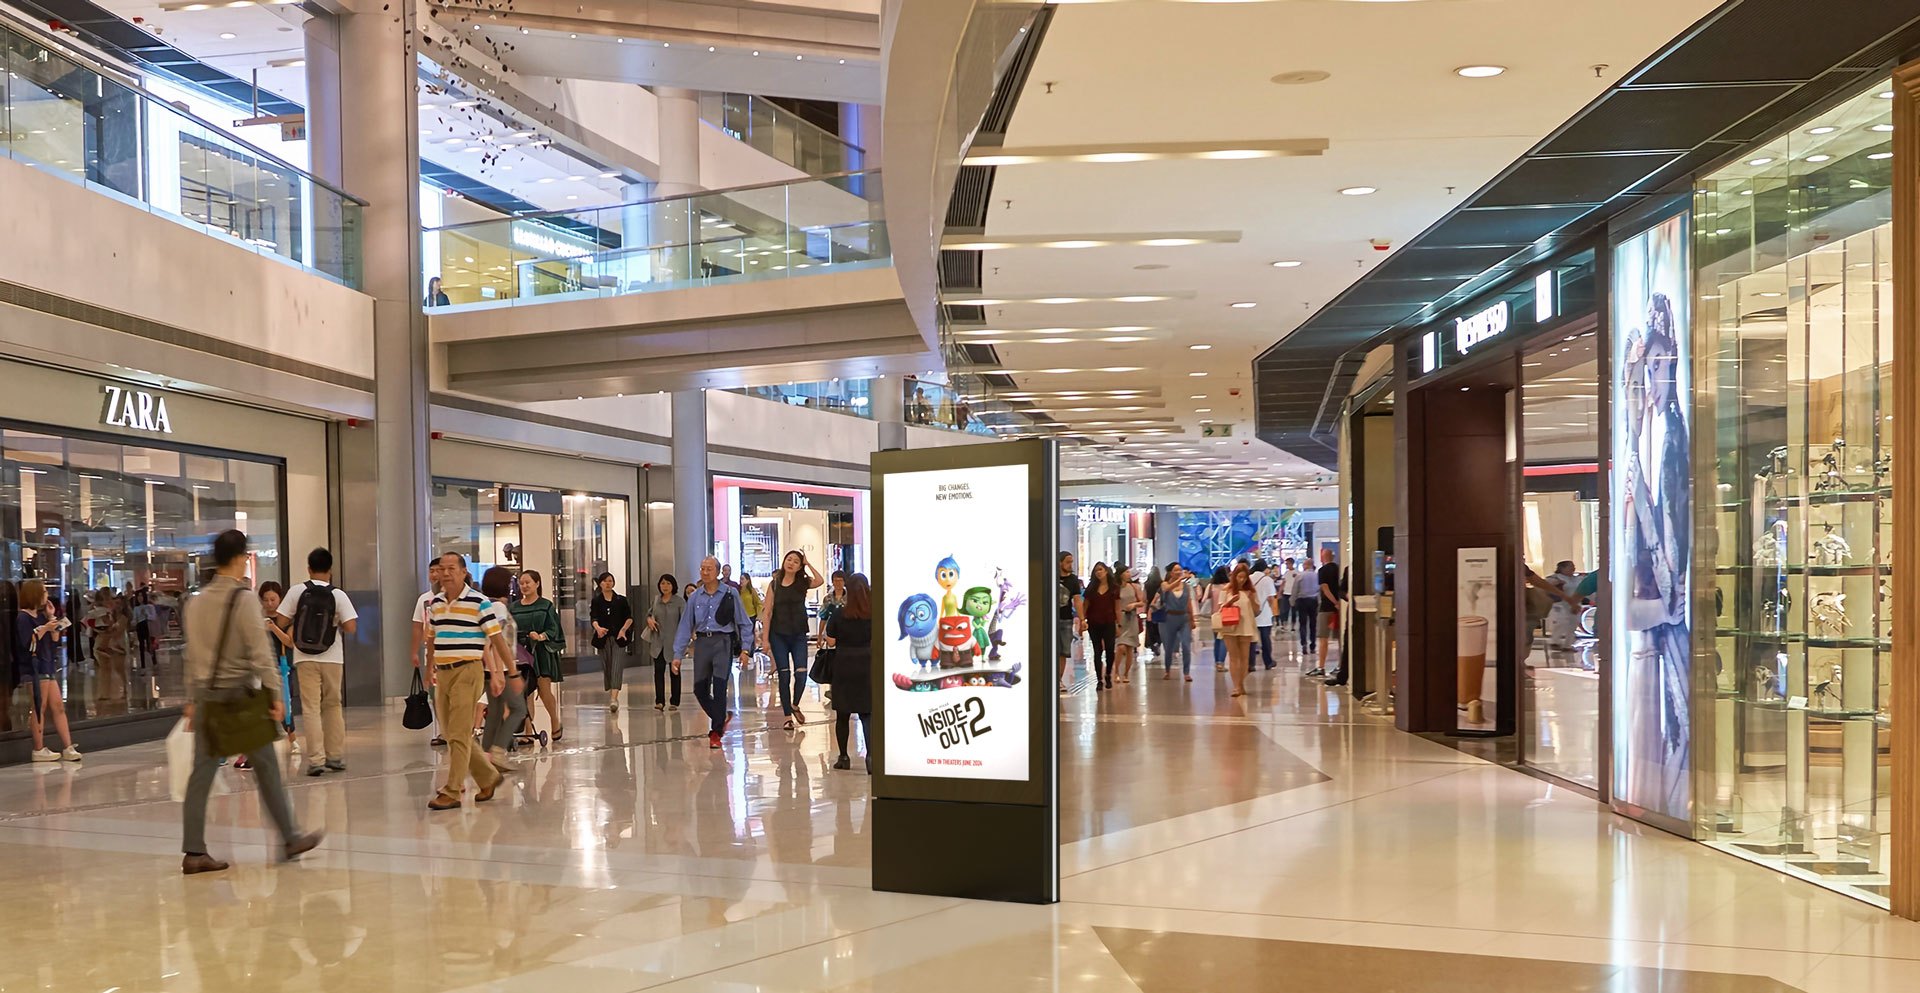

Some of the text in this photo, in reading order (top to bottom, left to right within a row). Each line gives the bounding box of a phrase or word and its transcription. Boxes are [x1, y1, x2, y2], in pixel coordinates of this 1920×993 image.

[105, 385, 173, 433] ZARA
[510, 492, 536, 511] ZARA
[792, 492, 810, 509] Dior
[917, 703, 968, 738] INSIDE
[939, 696, 992, 749] OUT 2
